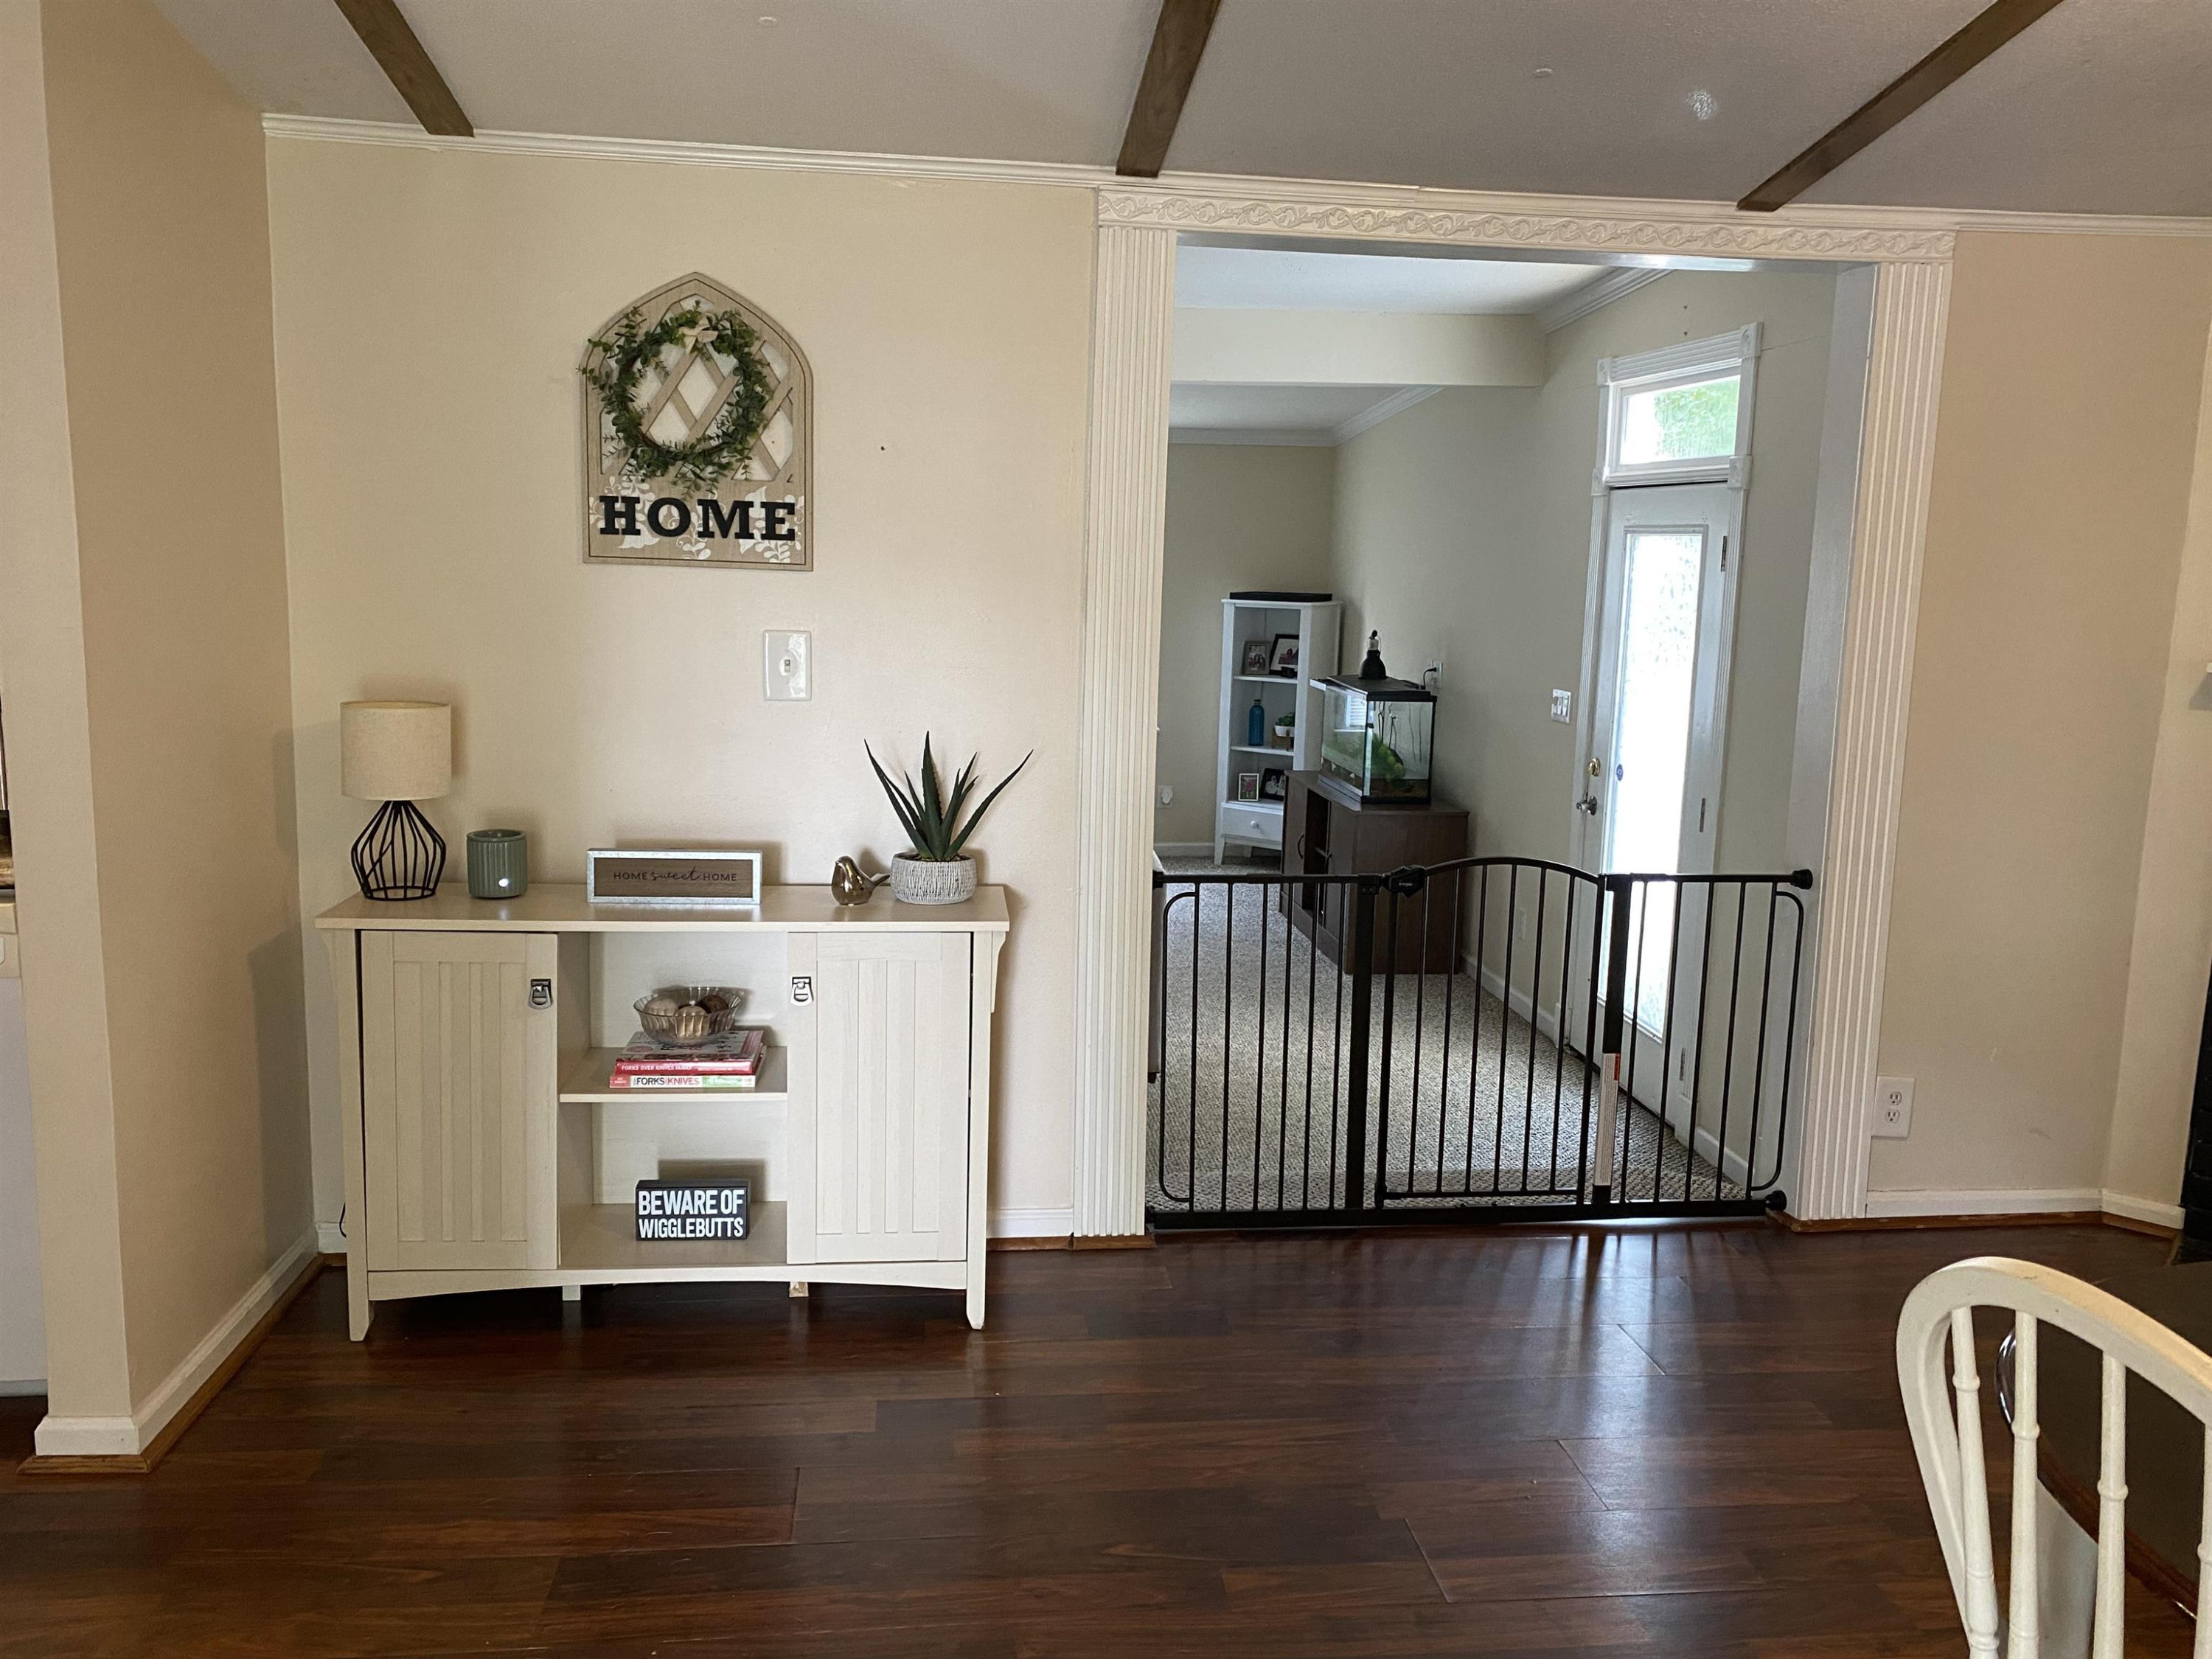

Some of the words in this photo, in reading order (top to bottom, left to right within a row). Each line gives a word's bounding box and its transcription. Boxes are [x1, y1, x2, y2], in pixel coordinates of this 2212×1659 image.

[599, 495, 796, 541] HOME
[613, 872, 647, 881] HOME
[651, 866, 700, 881] sweet
[703, 873, 737, 882] HOME
[636, 1077, 665, 1085] FORKS
[667, 1077, 700, 1085] KNIVES
[638, 1189, 718, 1216] BEWARE
[720, 1189, 745, 1215] OF
[638, 1217, 745, 1239] WIGGLEBUTTS
